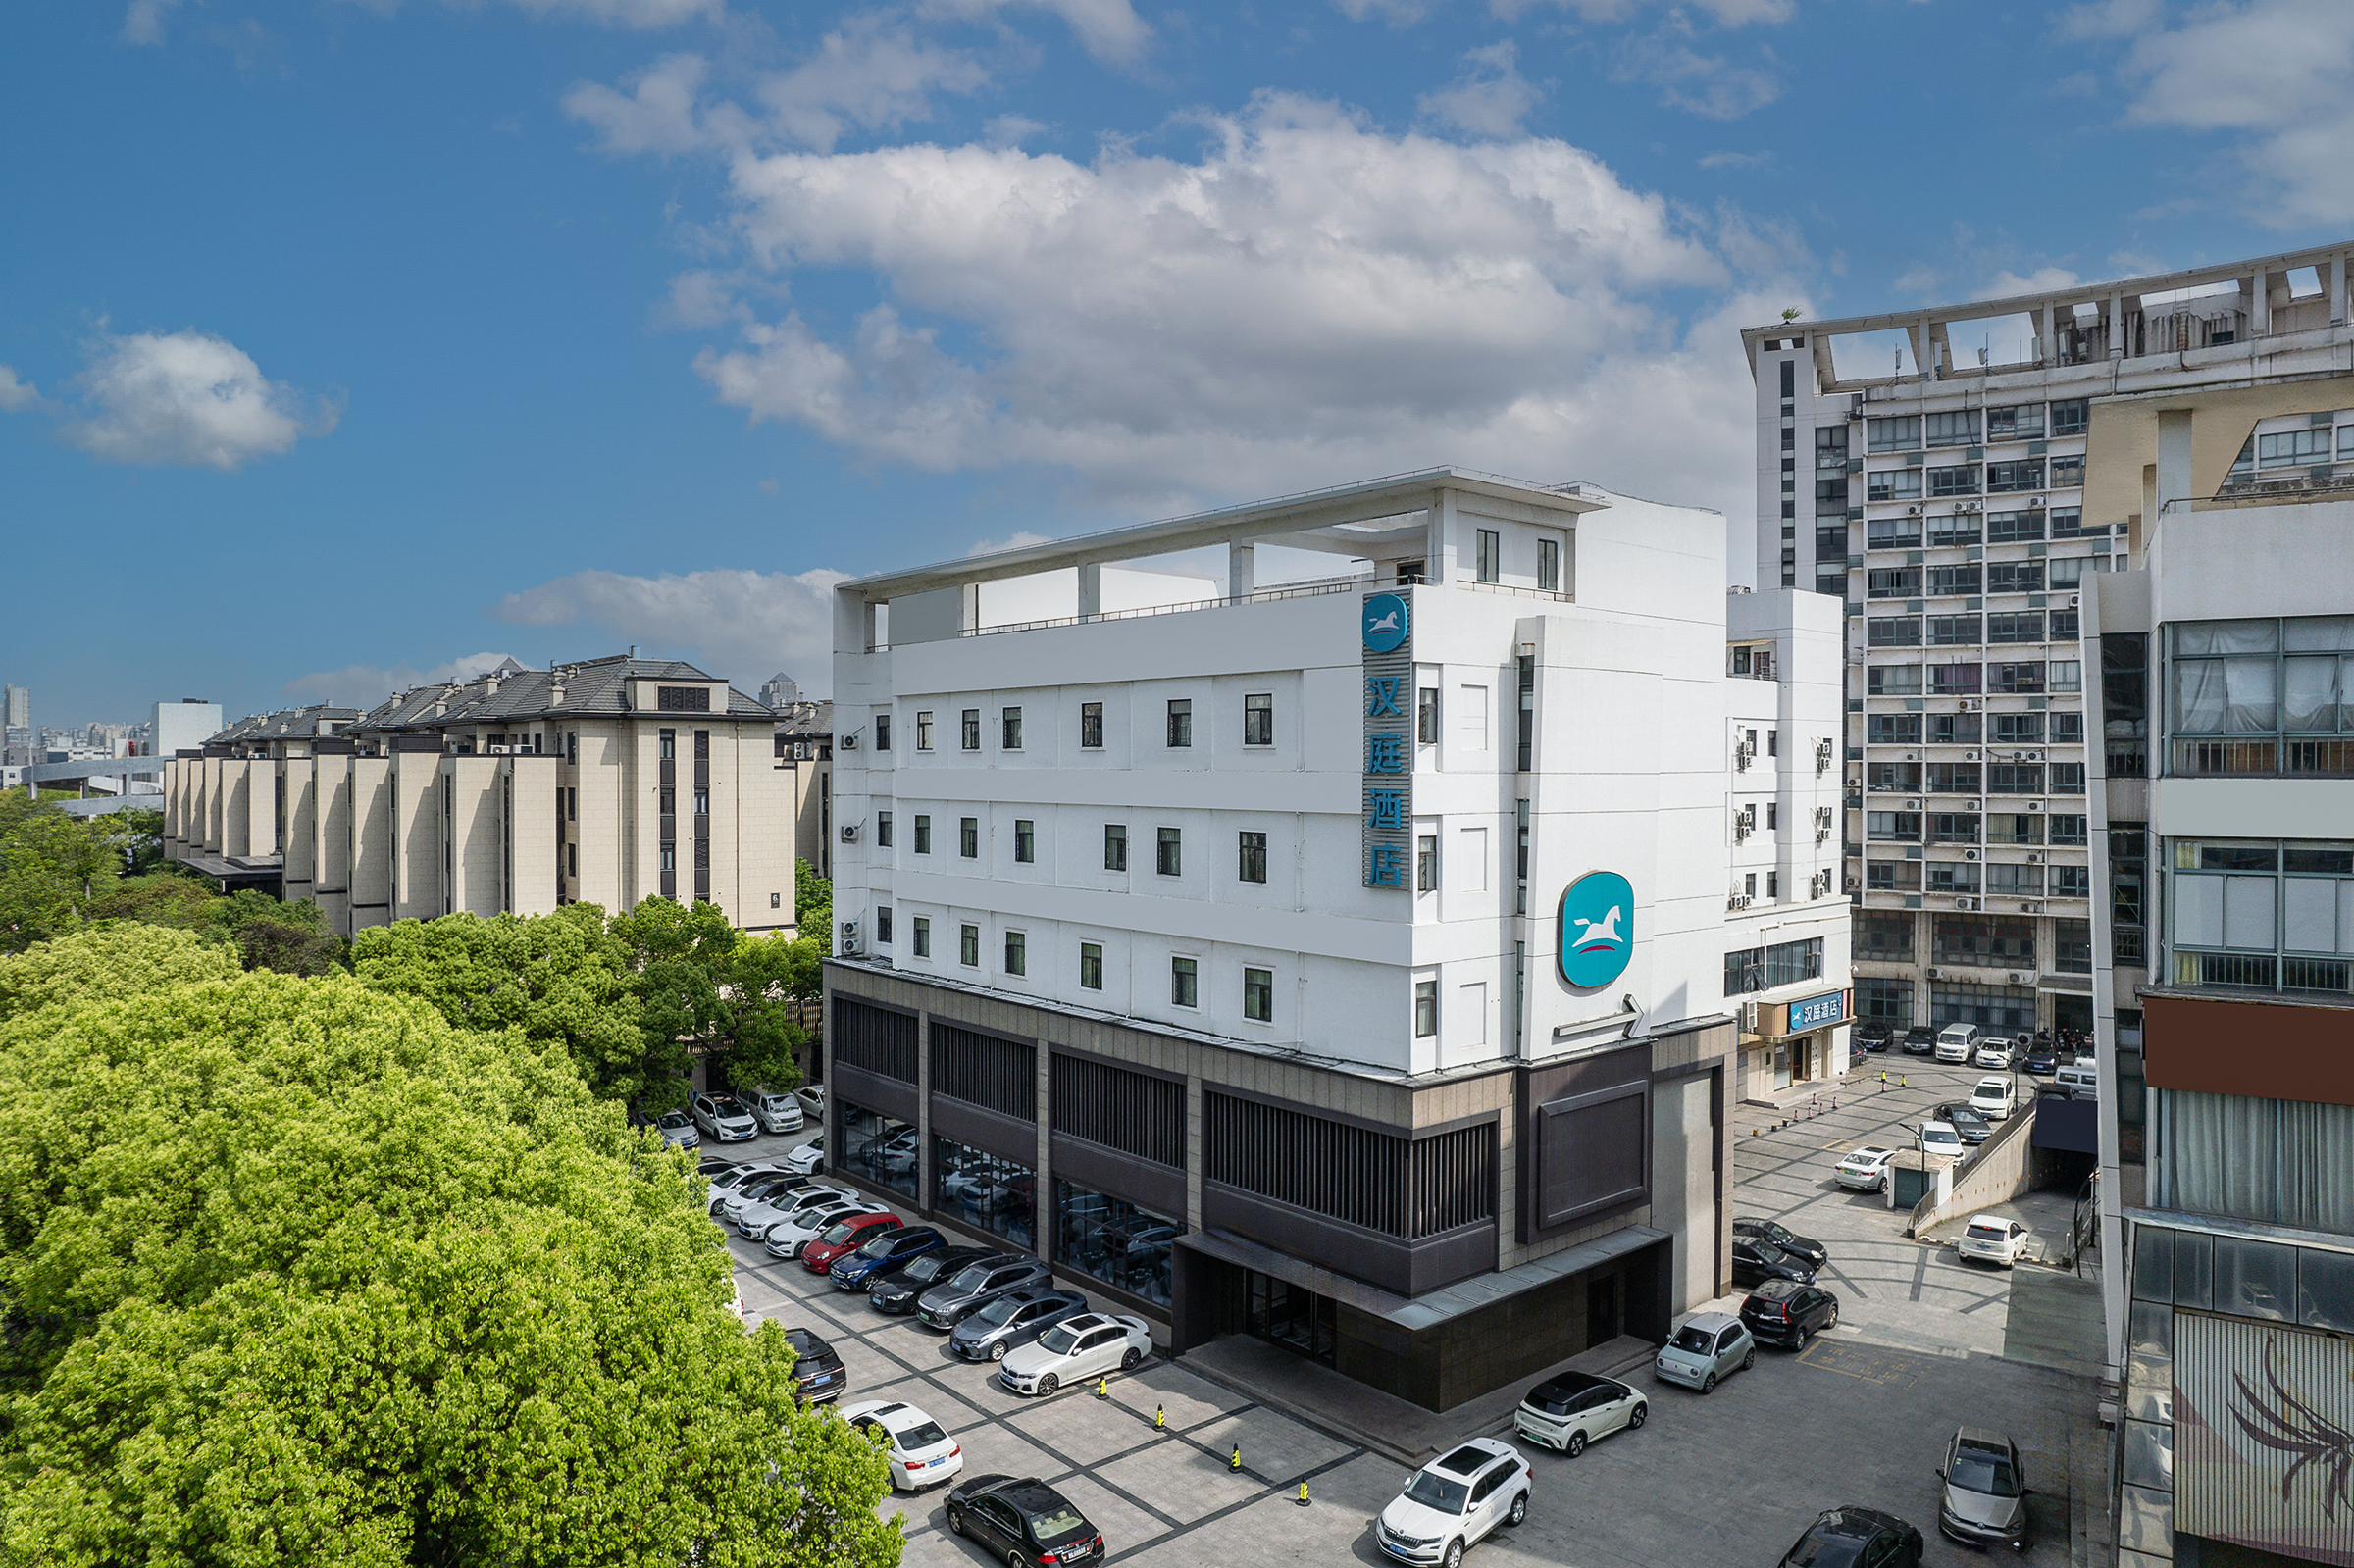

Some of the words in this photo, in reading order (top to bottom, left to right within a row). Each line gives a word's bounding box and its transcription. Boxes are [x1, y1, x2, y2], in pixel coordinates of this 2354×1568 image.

[1367, 676, 1403, 886] 汉庭酒店
[1803, 999, 1838, 1023] 汉庭酒店
